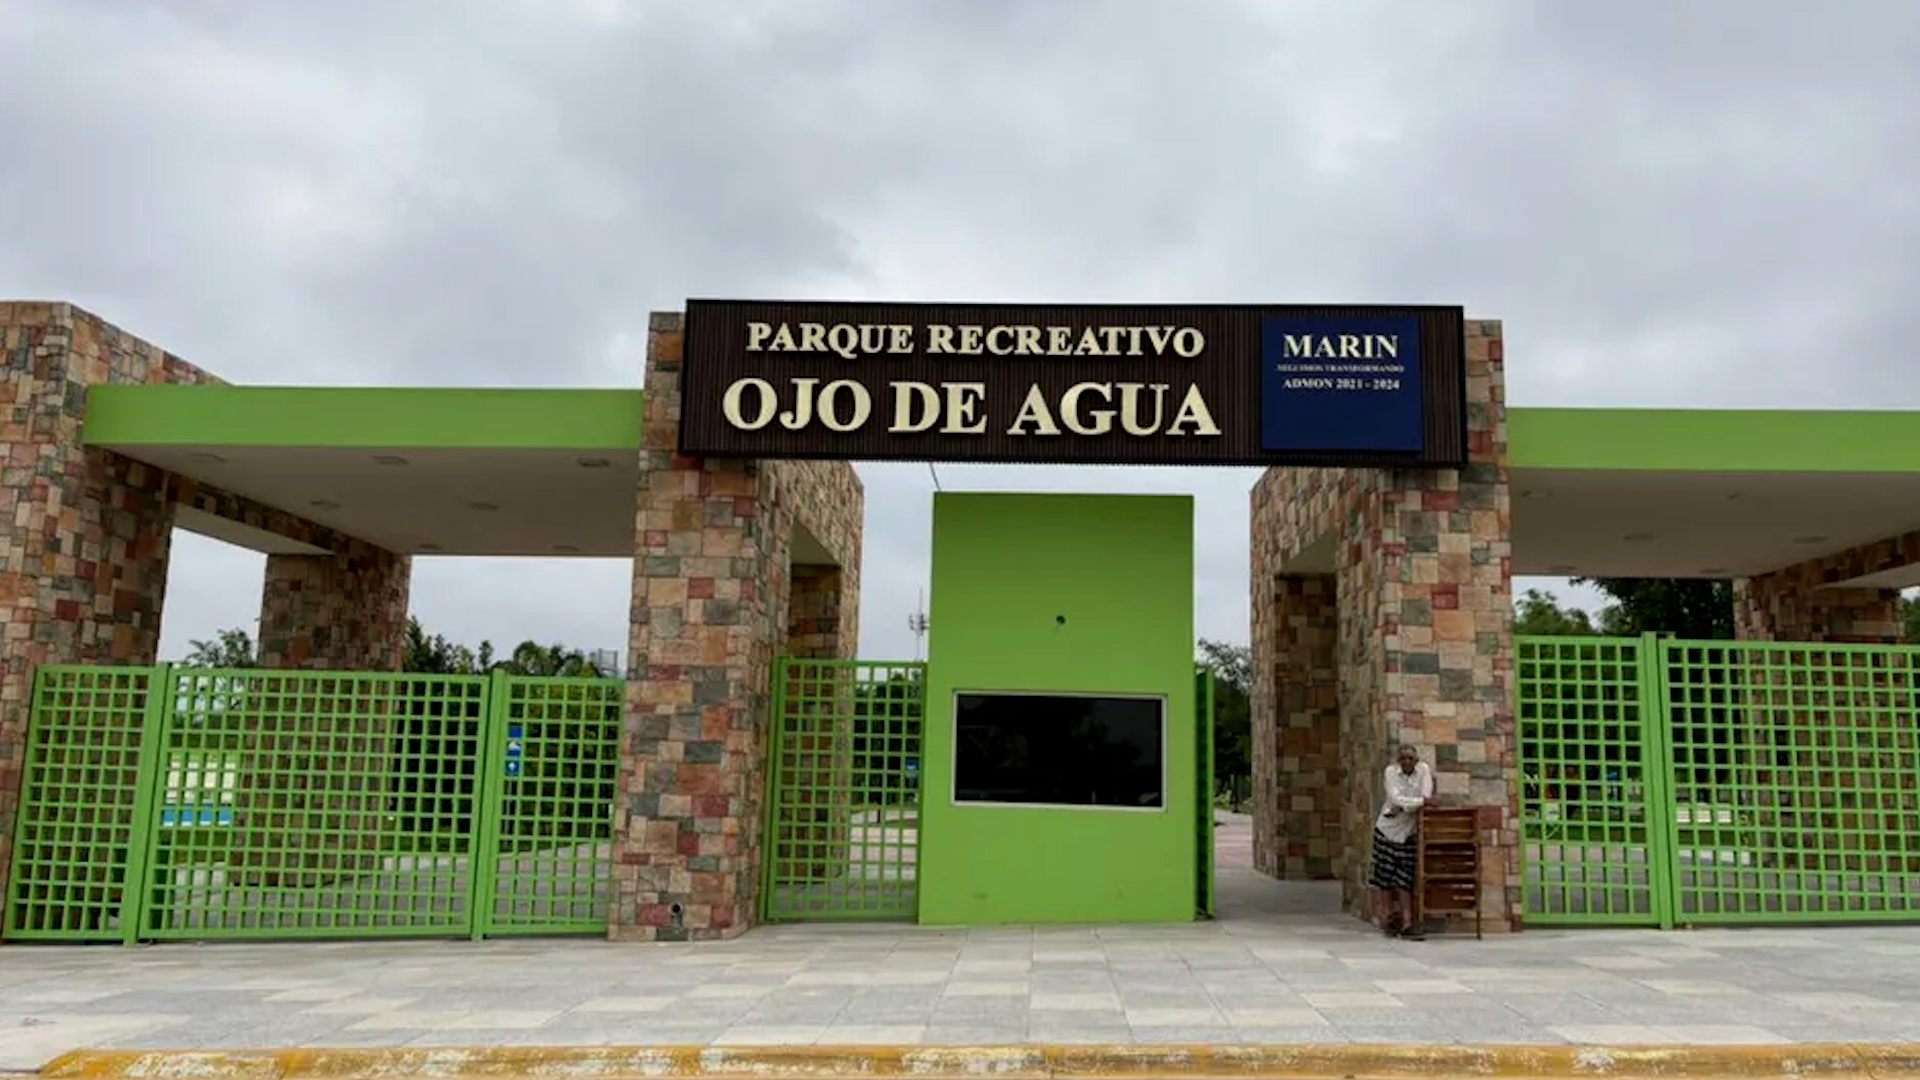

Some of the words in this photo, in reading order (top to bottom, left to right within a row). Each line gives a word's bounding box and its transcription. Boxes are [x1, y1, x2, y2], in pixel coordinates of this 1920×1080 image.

[746, 322, 914, 358] PARQUE
[926, 324, 1204, 358] RECREATIVO
[1283, 334, 1399, 358] MARIN
[1283, 378, 1333, 389] ADMON
[1336, 378, 1363, 390] 2021
[1373, 378, 1400, 390] 2024
[722, 378, 872, 432] OJO
[888, 382, 988, 434] DE
[1006, 382, 1222, 437] AGUA
